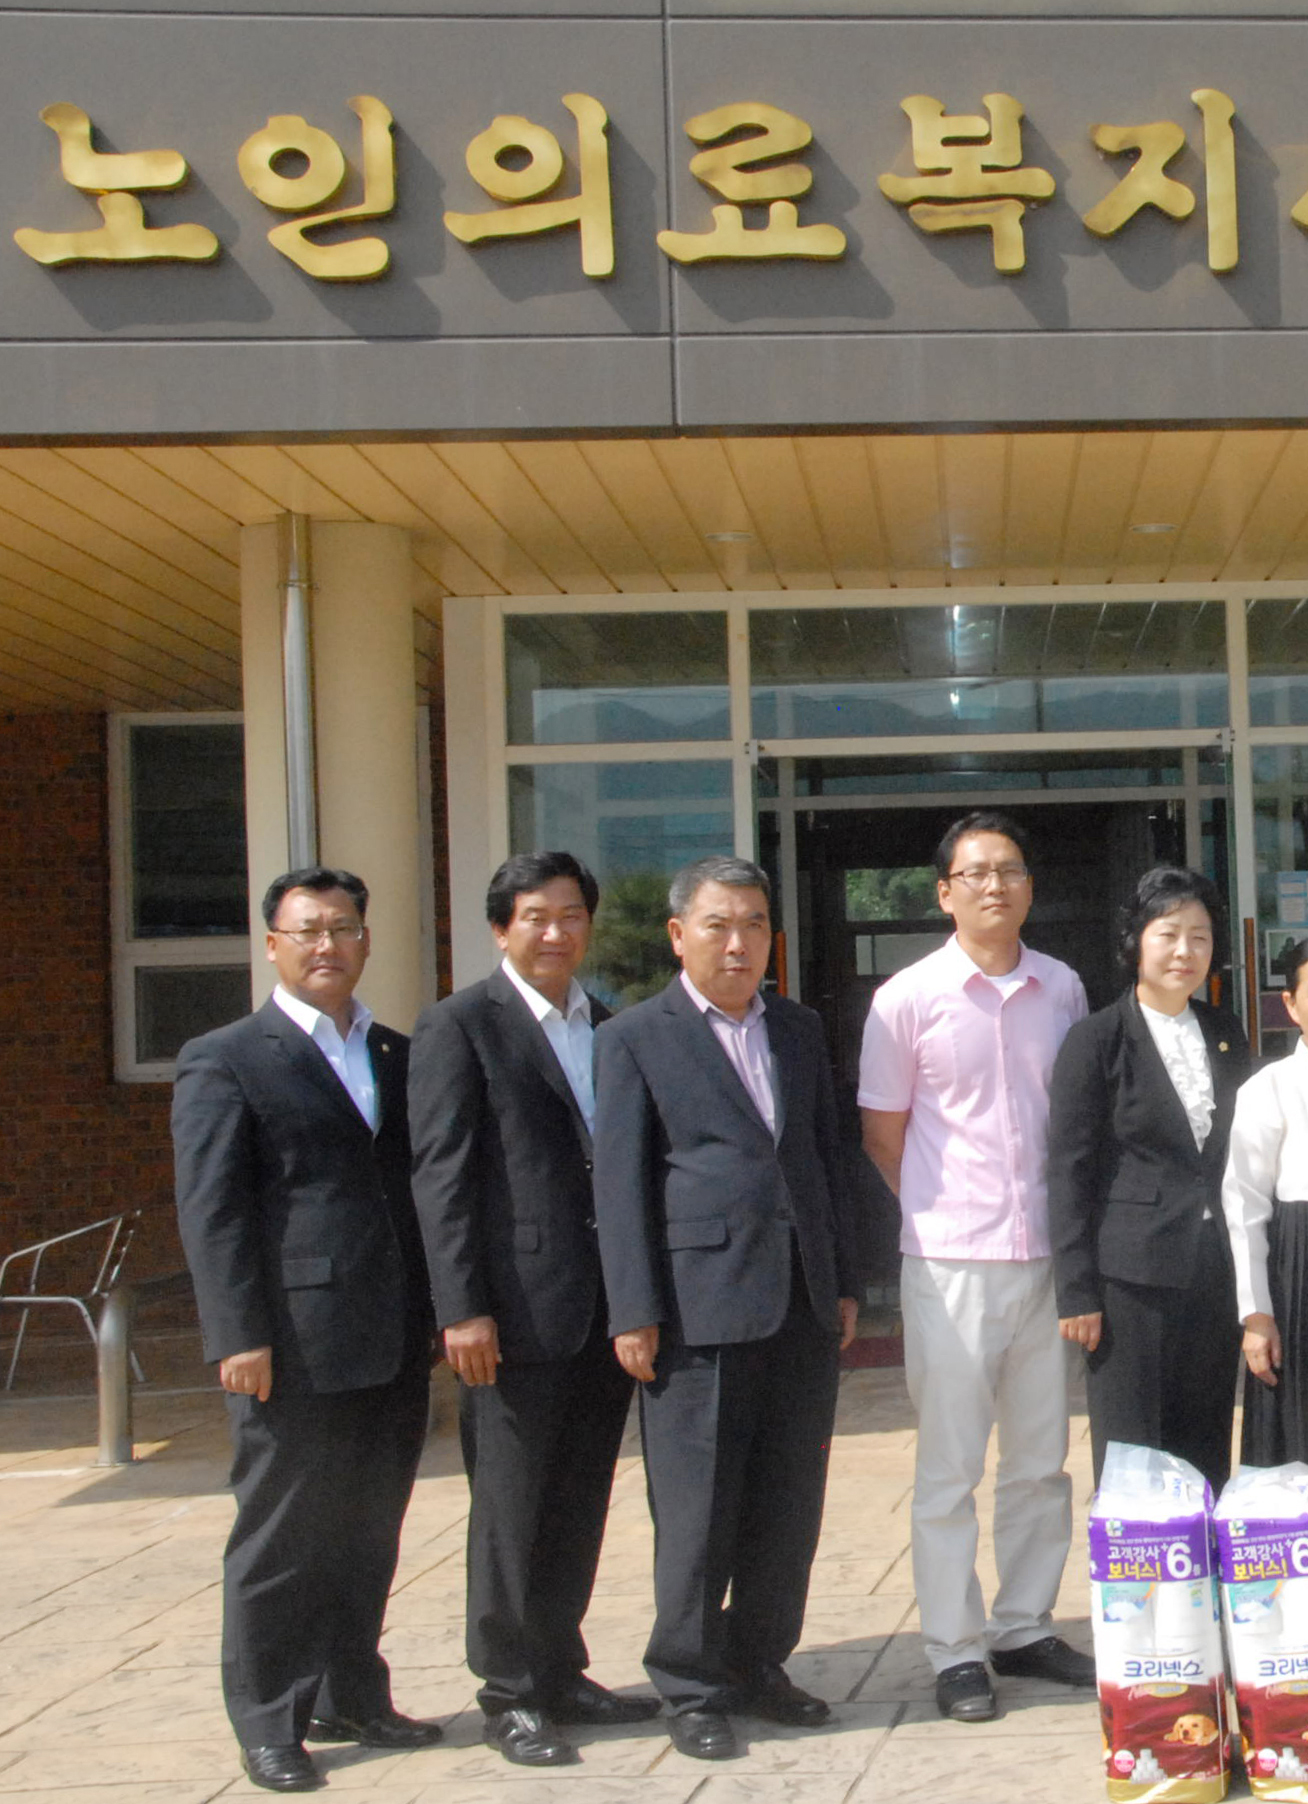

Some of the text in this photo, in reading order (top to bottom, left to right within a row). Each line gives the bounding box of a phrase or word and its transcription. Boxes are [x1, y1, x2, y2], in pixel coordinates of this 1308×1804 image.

[1107, 1561, 1162, 1580] 보너스!
[1233, 1559, 1288, 1581] 보너스!
[1123, 1660, 1204, 1678] 크리넥스
